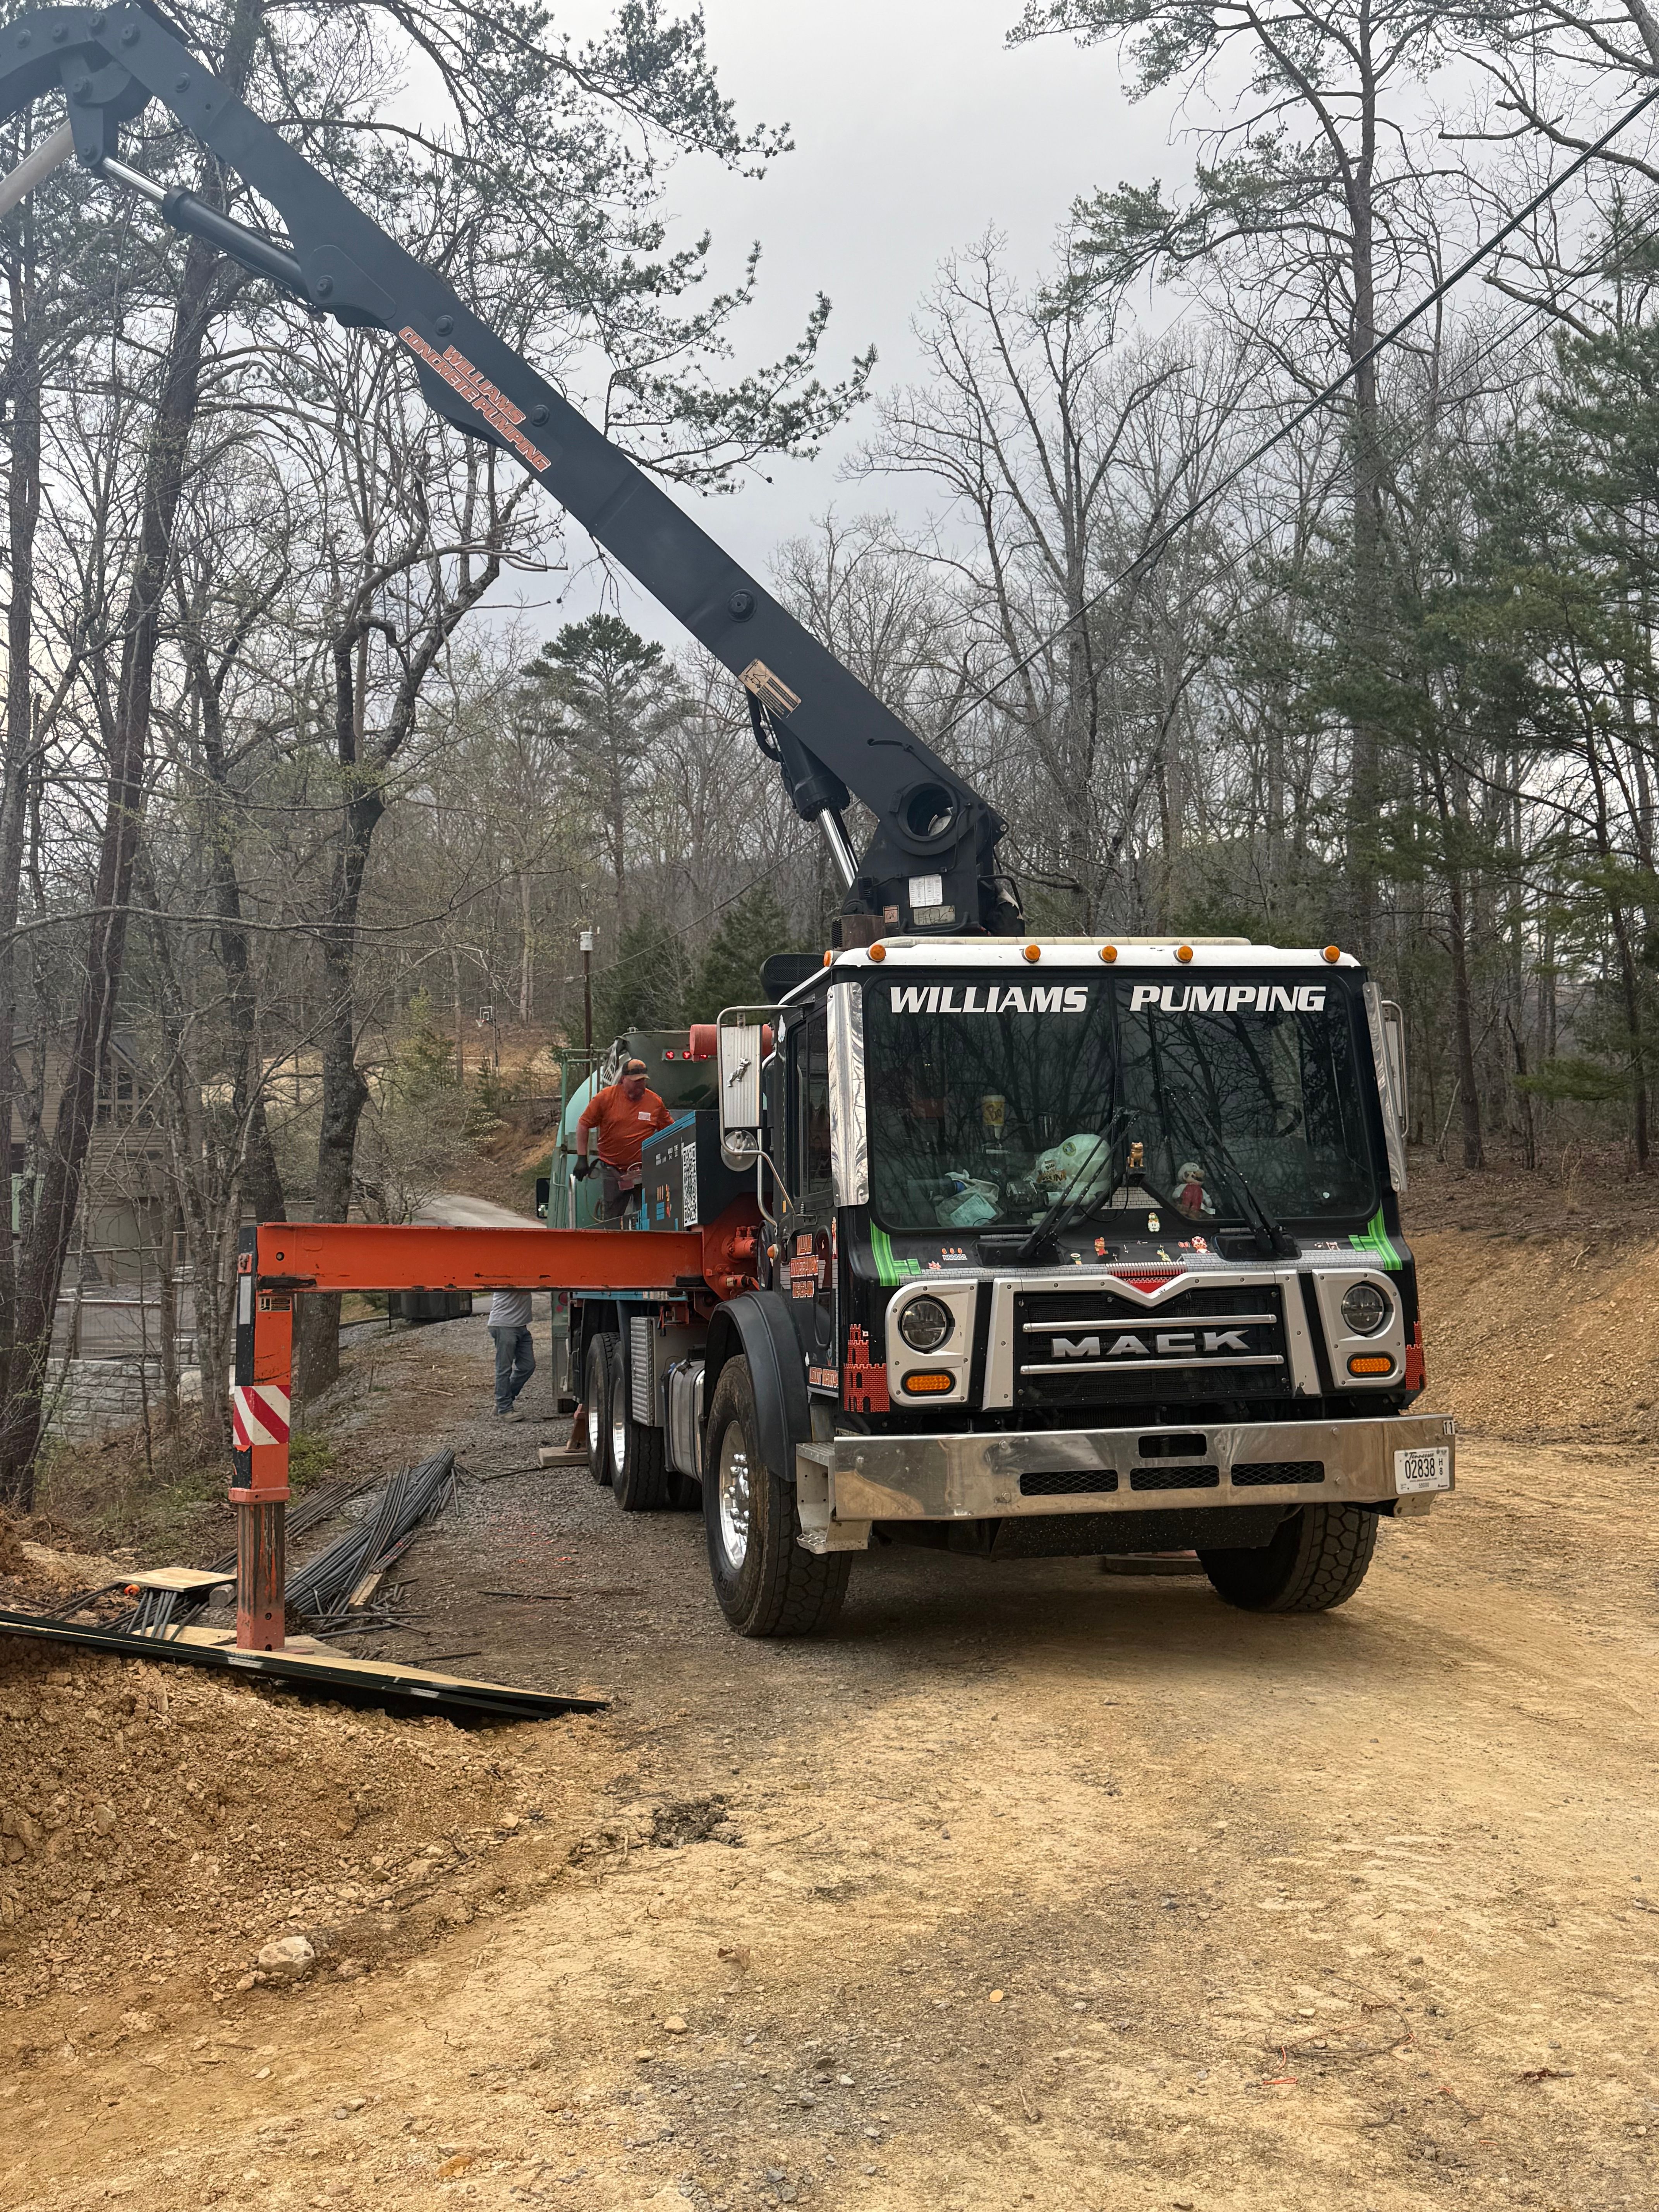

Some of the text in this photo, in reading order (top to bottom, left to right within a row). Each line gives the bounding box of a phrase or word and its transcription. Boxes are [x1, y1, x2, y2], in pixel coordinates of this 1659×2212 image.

[443, 345, 526, 425] WILLIAMS
[398, 326, 551, 472] CONCRETE PUMPING
[890, 986, 1326, 1013] WILLIAMS PUMPING
[1051, 1329, 1250, 1358] MACK
[1444, 1421, 1453, 1434] 11
[1405, 1458, 1435, 1479] 02838
[1408, 1452, 1434, 1460] Tennessee
